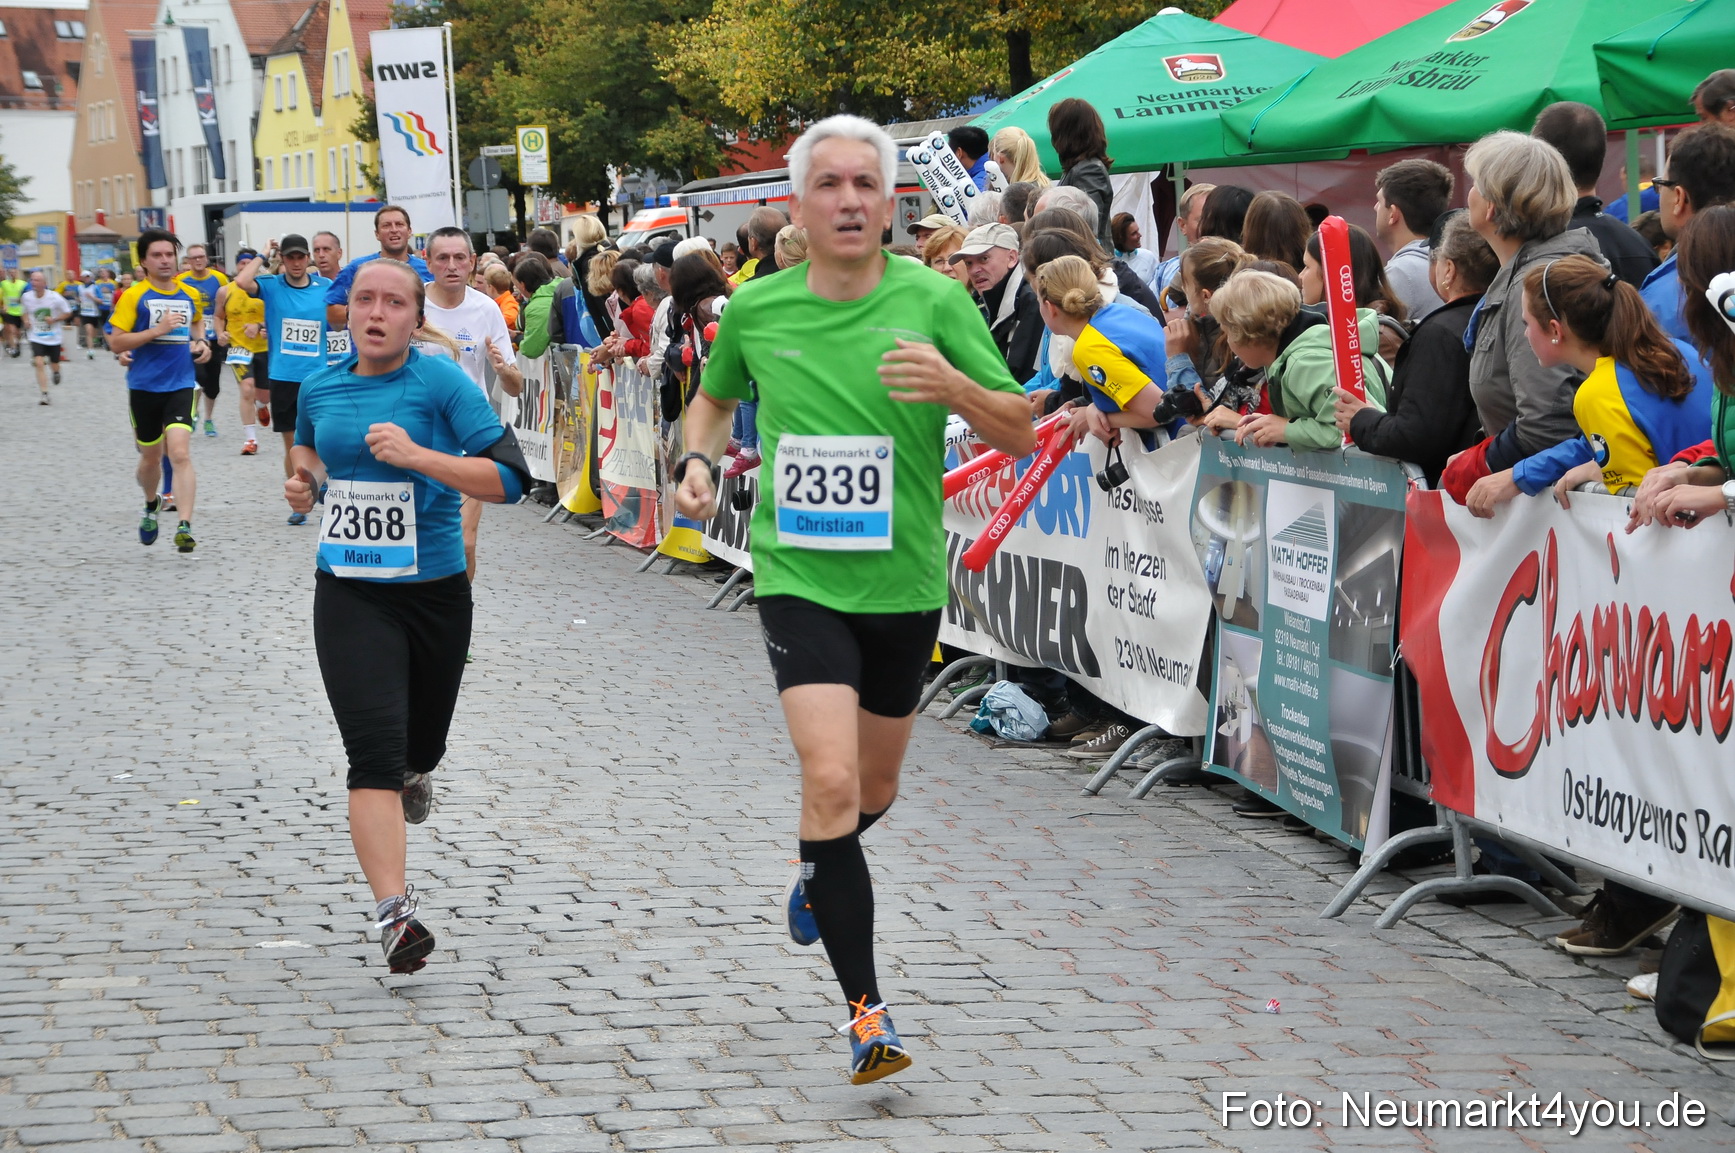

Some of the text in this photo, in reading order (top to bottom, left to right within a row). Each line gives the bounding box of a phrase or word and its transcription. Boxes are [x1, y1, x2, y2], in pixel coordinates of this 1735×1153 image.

[1113, 96, 1247, 120] Lamms
[942, 153, 967, 180] BMW
[285, 327, 317, 344] 2192
[1346, 316, 1364, 391] Audi BKK
[779, 444, 870, 458] PARTL Neumarkt
[1034, 454, 1053, 483] Audi
[1296, 465, 1306, 479] und
[1368, 477, 1387, 495] Bayern
[326, 489, 395, 501] PARTL Neumarkt
[784, 463, 880, 505] 2339
[1013, 483, 1034, 508] BKK
[327, 504, 406, 541] 2368
[796, 515, 864, 533] Christian
[344, 550, 382, 564] Maria
[1104, 537, 1167, 581] Im Herzen
[1296, 550, 1329, 576] HOFFER
[1298, 577, 1326, 593] TROCKENBAU
[1107, 578, 1157, 620] der Stadt
[1274, 628, 1289, 647] 92318
[1290, 633, 1309, 654] Neumarkt
[1285, 653, 1300, 671] 09181
[1303, 659, 1320, 679] 460170
[1281, 702, 1310, 728] Trockenbau
[1266, 718, 1326, 756] Fassadenverkleidungen
[1298, 769, 1334, 797] Sanierungen
[1563, 768, 1735, 868] Ostbayerns Ra
